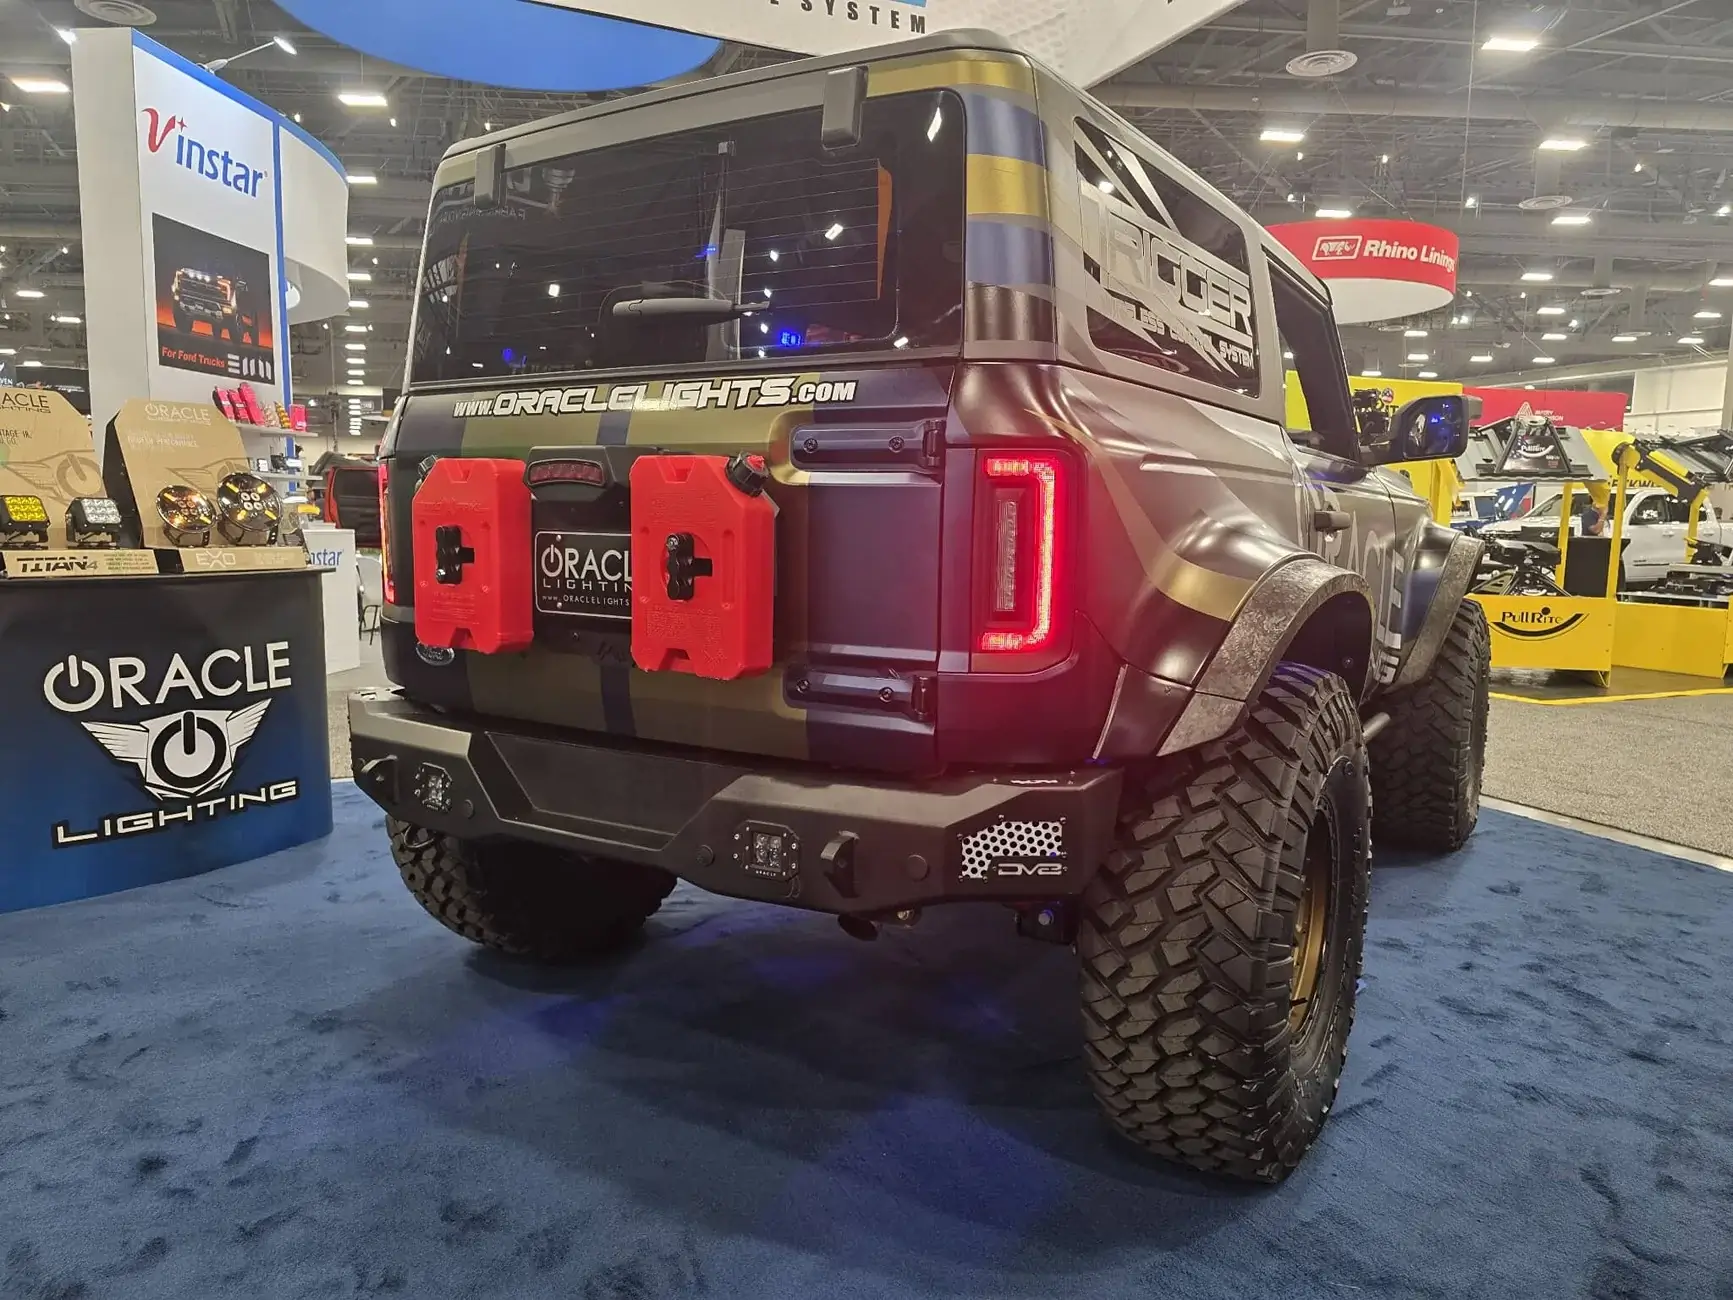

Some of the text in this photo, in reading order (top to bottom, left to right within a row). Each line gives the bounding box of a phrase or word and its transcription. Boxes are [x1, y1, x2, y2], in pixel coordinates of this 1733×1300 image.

[801, 0, 926, 34] SYSTEM
[141, 107, 263, 198] Vinstar
[1363, 239, 1418, 260] Rhino
[161, 346, 225, 368] For Ford Trucks
[145, 403, 211, 421] ORACLE
[541, 544, 632, 582] ORACL
[543, 578, 632, 593] LIGHTIN
[43, 641, 292, 713] ORACLE
[57, 780, 297, 843] LIGHTING
